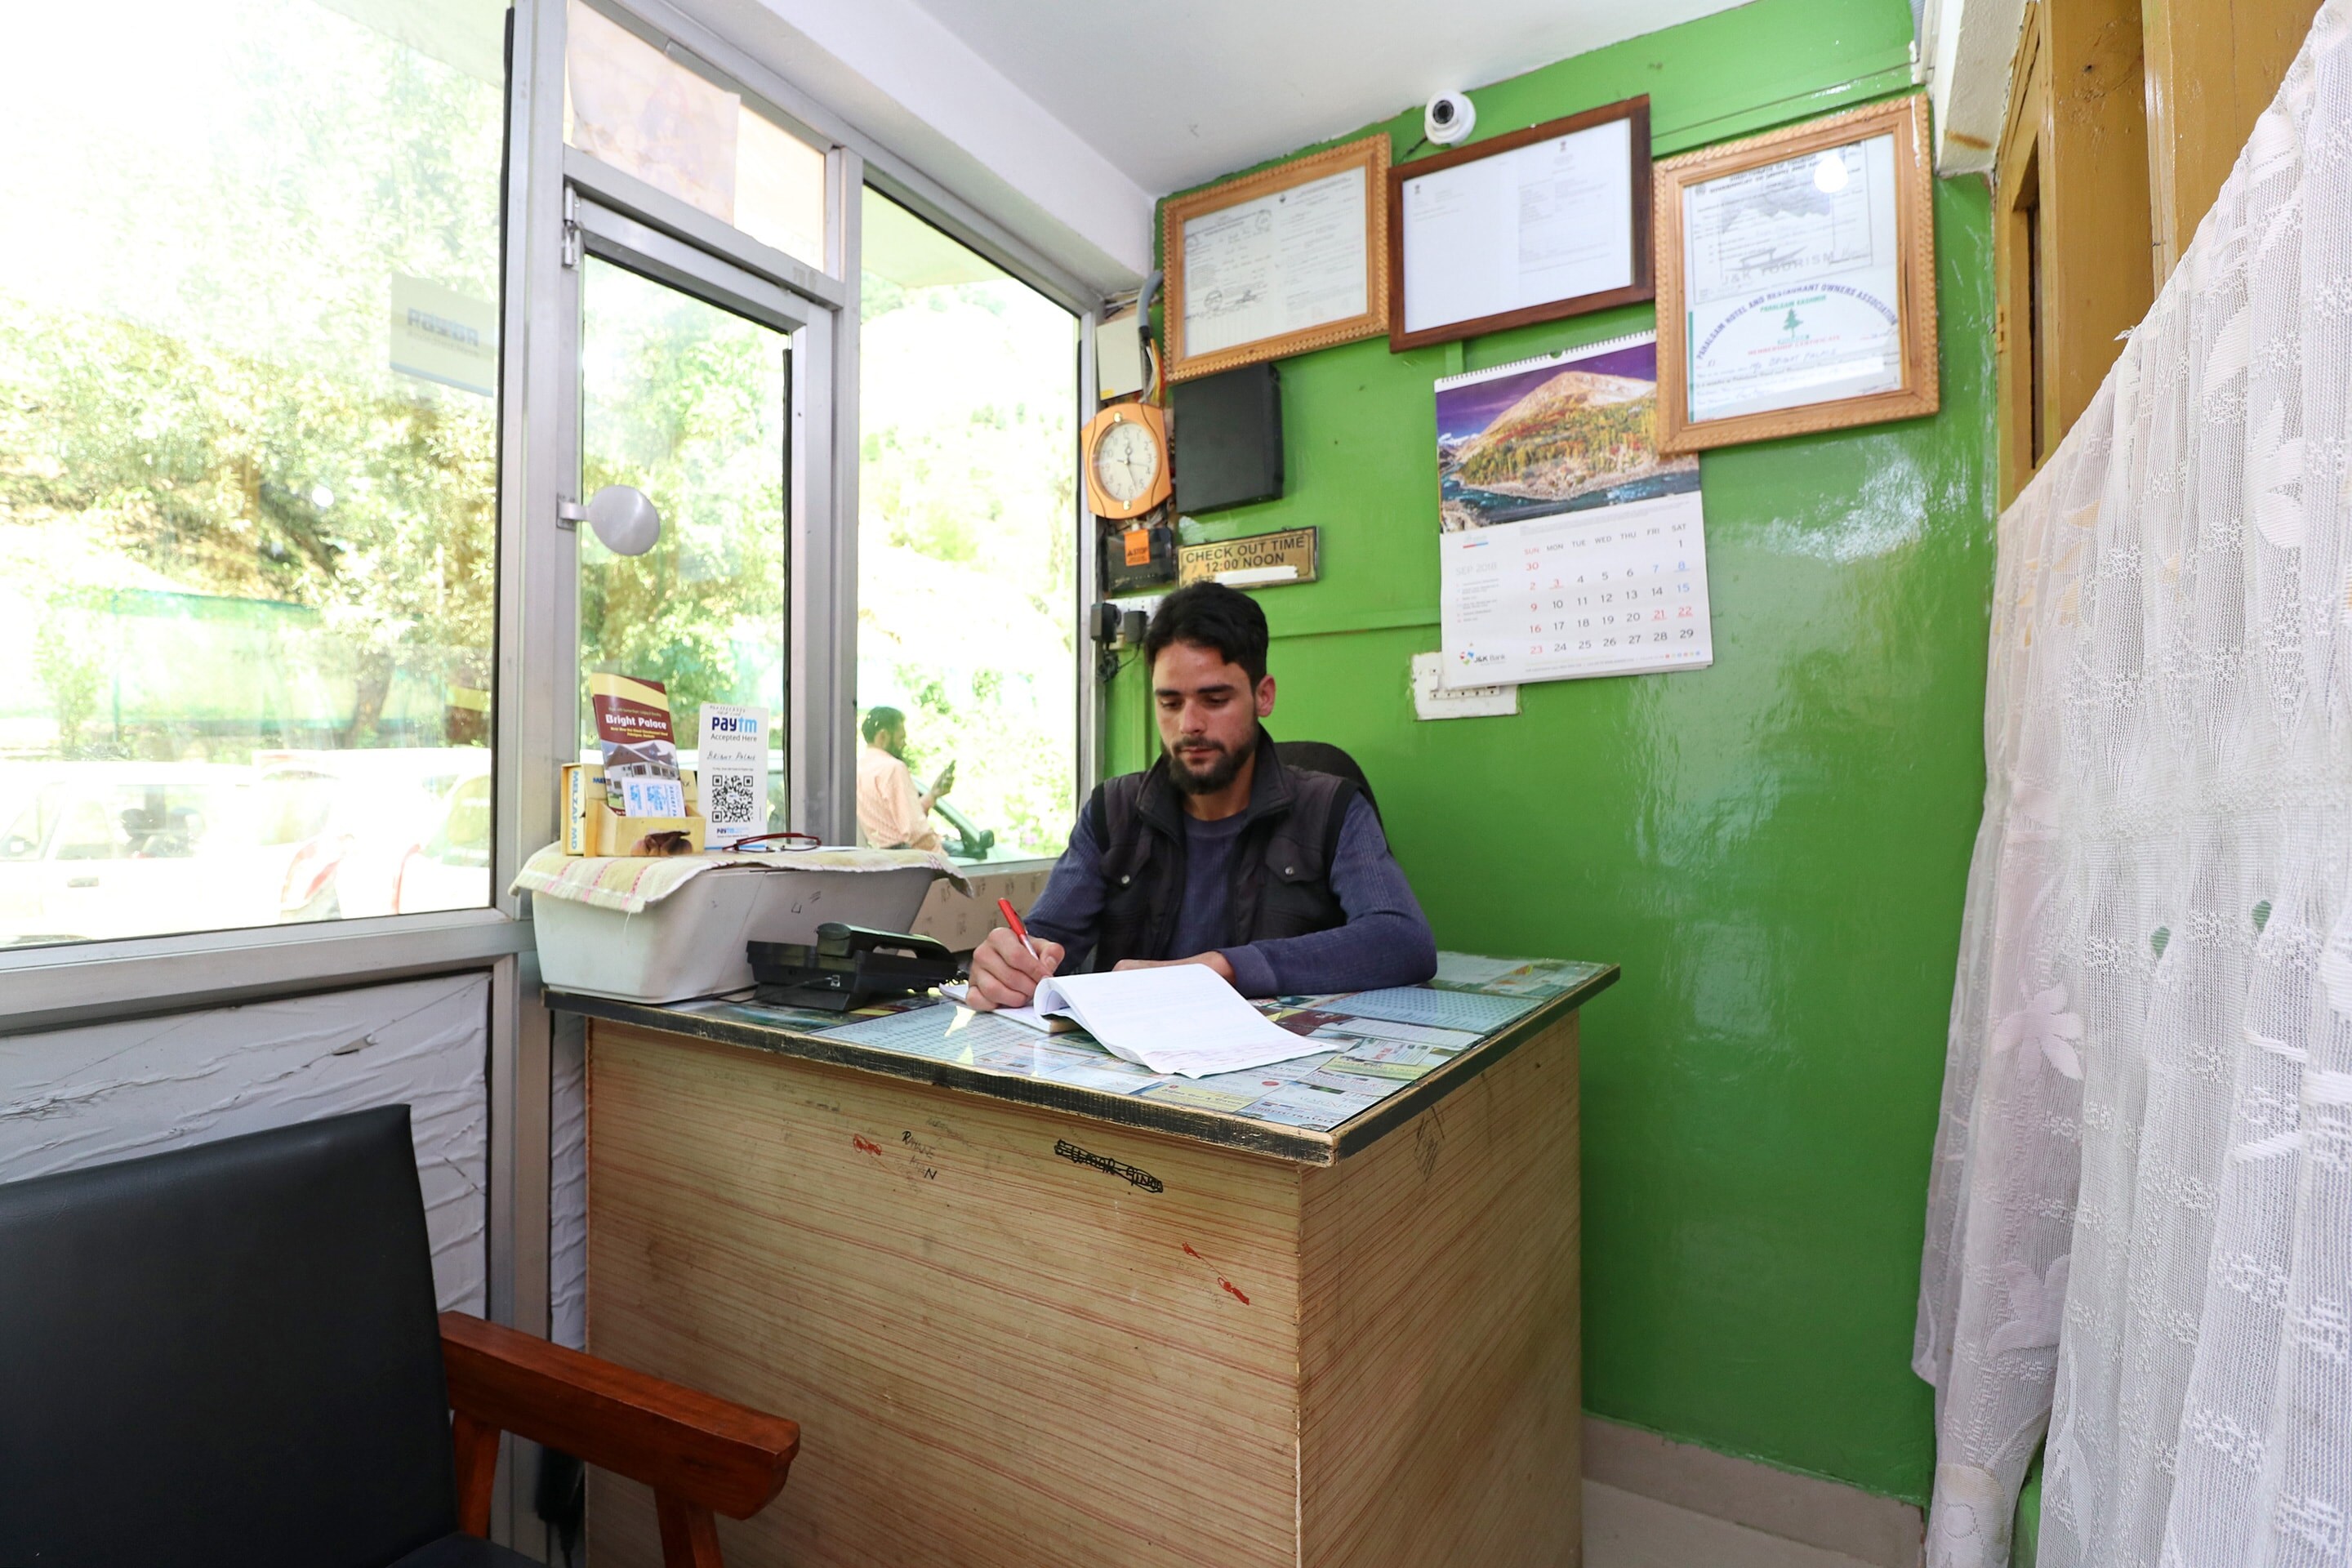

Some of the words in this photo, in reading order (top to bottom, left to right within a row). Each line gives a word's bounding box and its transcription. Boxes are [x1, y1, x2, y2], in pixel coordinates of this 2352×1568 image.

[1820, 283, 1856, 296] OWNERS
[1186, 547, 1232, 564] CHECK
[1237, 542, 1267, 556] OUT
[1272, 536, 1305, 551] TIME
[1524, 547, 1539, 555] SUN
[1595, 536, 1612, 544] WED
[1646, 528, 1660, 536] FRI
[1672, 523, 1686, 532] SAT
[1205, 559, 1239, 572] 12:00
[1243, 552, 1285, 568] NOON
[1526, 562, 1539, 571] 30
[1530, 582, 1536, 590] 2
[1577, 576, 1584, 584] 4
[1601, 572, 1609, 580] 5
[1626, 568, 1633, 577] 6
[1652, 564, 1659, 573] 7
[1677, 561, 1686, 570] 8
[1530, 603, 1538, 612] 9
[1552, 600, 1563, 608] 10
[1577, 597, 1588, 606] 11
[1601, 594, 1613, 603] 12
[1626, 590, 1638, 599] 13
[1652, 587, 1663, 596] 14
[1677, 583, 1690, 593] 15
[1530, 625, 1541, 634] 16
[1553, 621, 1565, 630] 17
[1578, 619, 1589, 628] 18
[1601, 616, 1614, 625] 19
[1626, 612, 1640, 622] 20
[1654, 610, 1664, 620] 21
[1677, 607, 1691, 617] 22
[1530, 646, 1543, 654] 23
[1554, 644, 1566, 652] 24
[1579, 640, 1592, 649] 25
[1603, 638, 1616, 647] 26
[1628, 635, 1641, 644] 27
[1654, 632, 1668, 641] 28
[1680, 630, 1694, 639] 29
[1474, 655, 1488, 663] J&K
[1490, 653, 1505, 662] Bank
[605, 714, 635, 727] Bright
[638, 717, 667, 730] Palace
[710, 733, 741, 742] Accepted
[572, 827, 579, 850] MD
